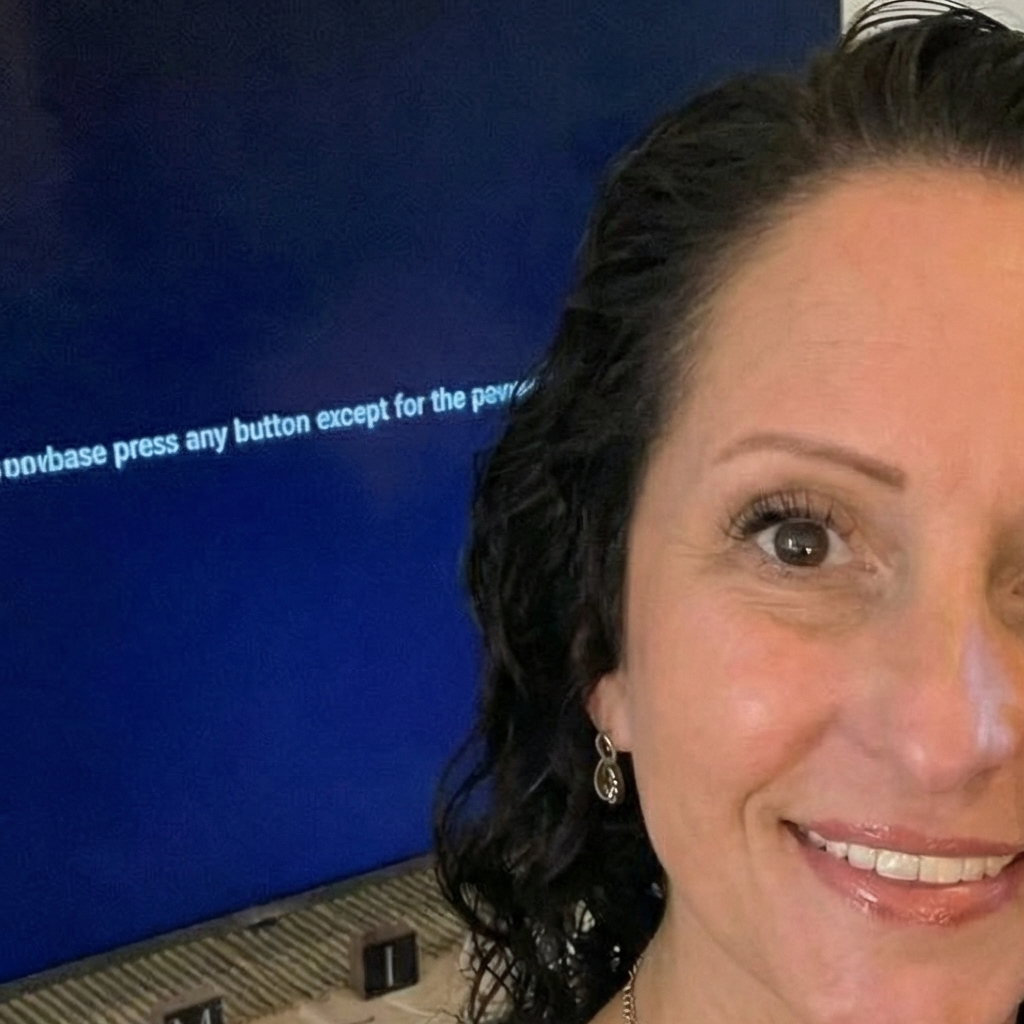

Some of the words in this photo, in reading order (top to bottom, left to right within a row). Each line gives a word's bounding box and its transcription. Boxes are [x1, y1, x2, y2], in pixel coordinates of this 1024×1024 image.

[113, 433, 179, 469] press
[185, 426, 228, 454] any
[233, 413, 310, 443] button
[316, 397, 390, 428] except
[395, 392, 425, 418] for
[431, 387, 466, 413] the
